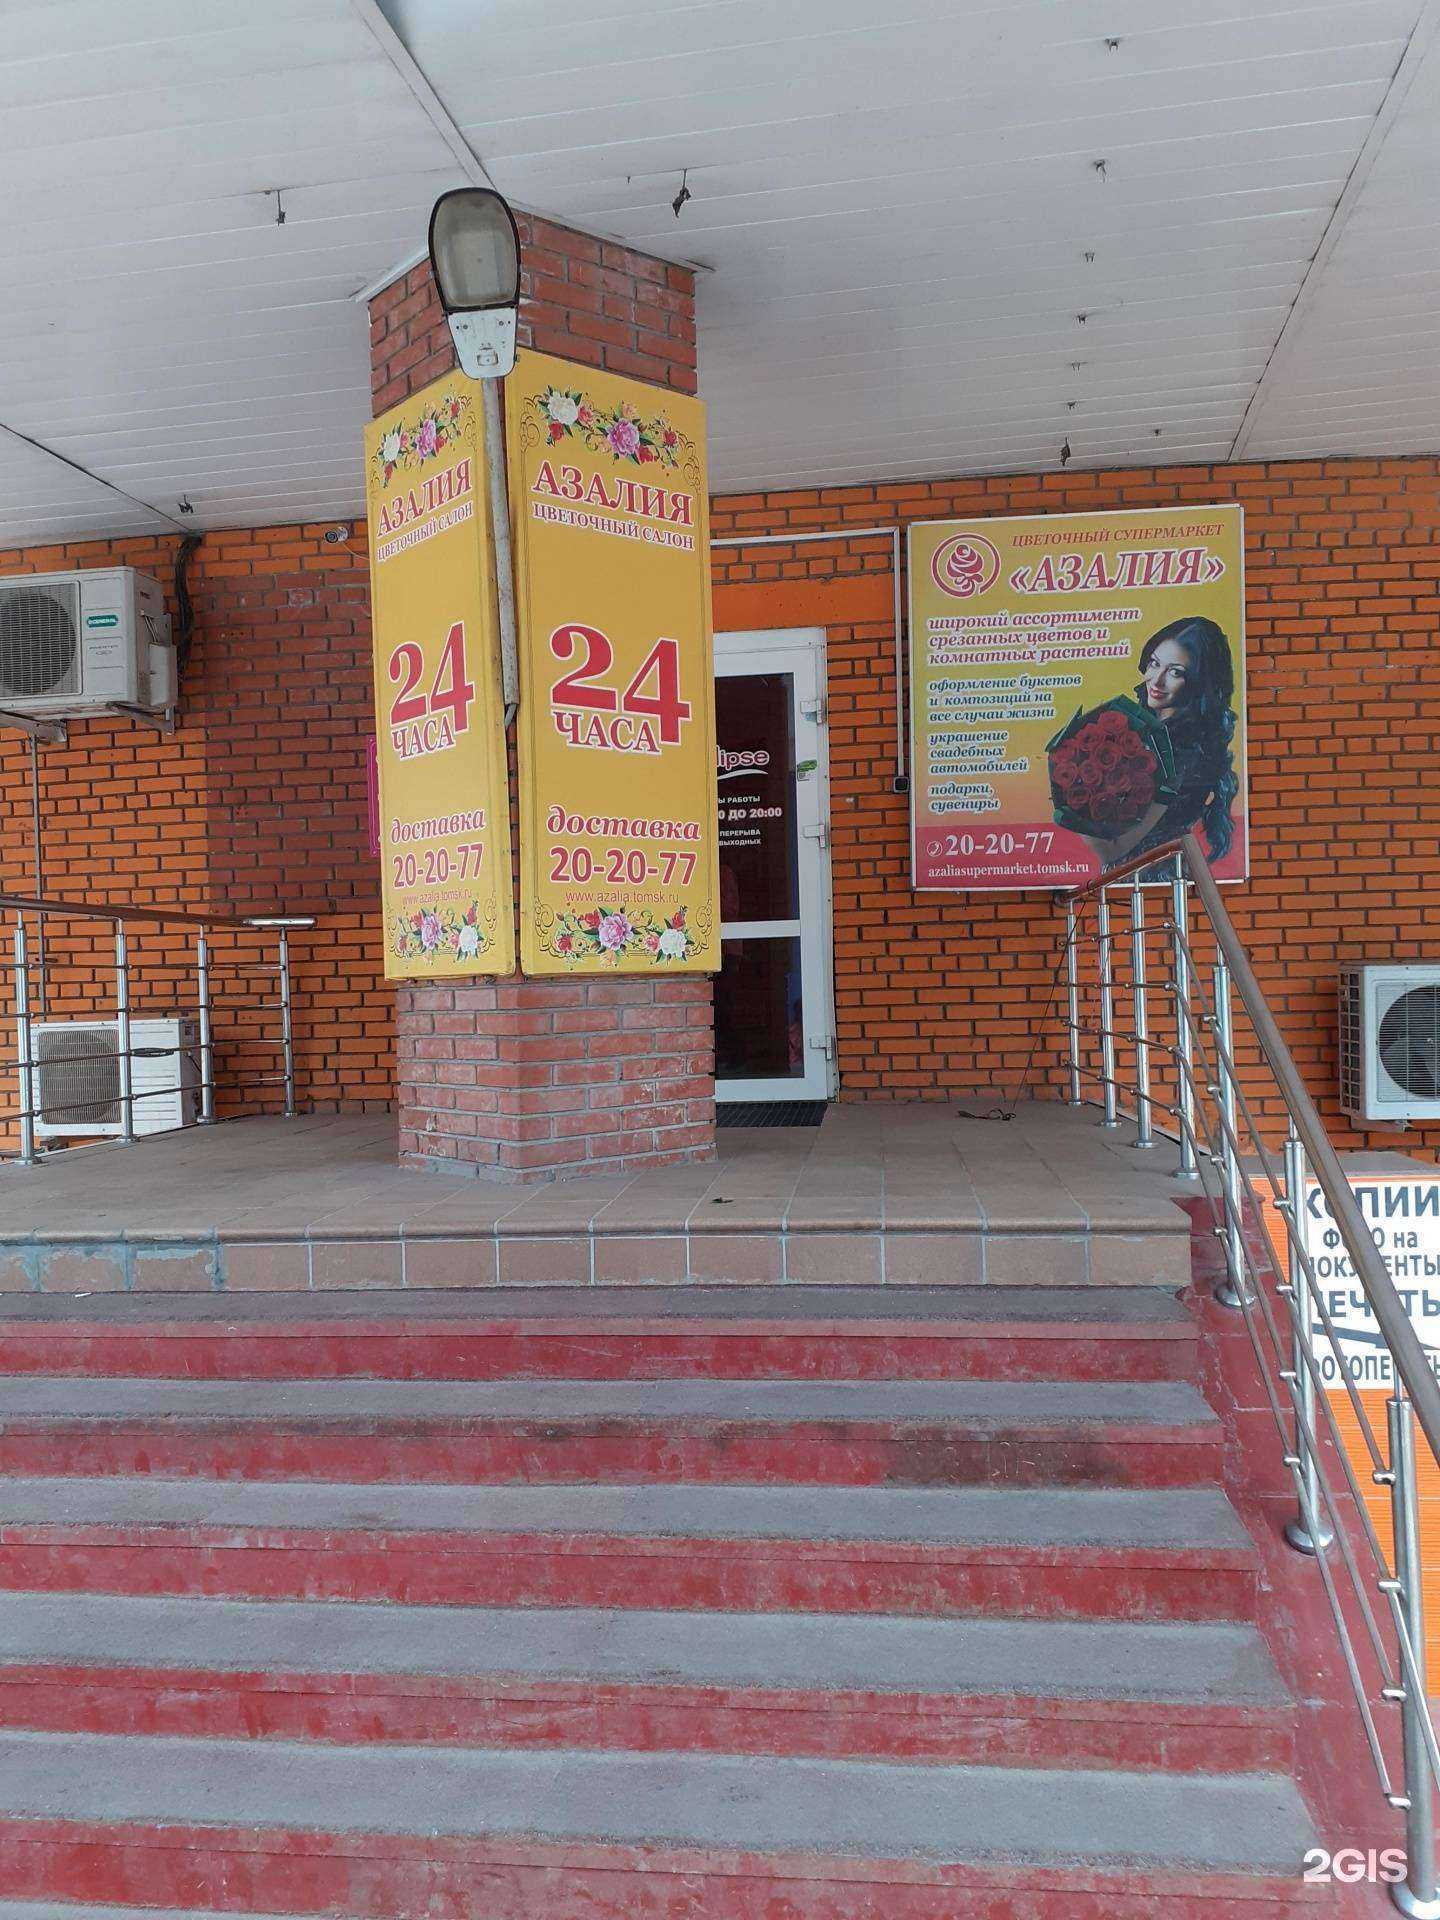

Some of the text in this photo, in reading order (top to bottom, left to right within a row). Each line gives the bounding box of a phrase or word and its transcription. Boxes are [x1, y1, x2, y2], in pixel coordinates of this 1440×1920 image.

[377, 459, 472, 538] АЗАЛИЯ
[532, 461, 693, 526] АЗАЛИЯ
[378, 502, 473, 560] ЦВЕТОЧНЫЙ САЛОН
[534, 503, 694, 549] ЦВЕТОЧНЫЙ САЛОН
[1012, 524, 1225, 547] ЦВЕТОЧНЫЙ СУПЕРМАРКЕТ
[1010, 549, 1225, 592] «АЗАЛИЯ»
[928, 607, 1140, 632] широкий ассортимент
[929, 629, 1108, 650] срезанных цветов и
[929, 642, 1130, 665] комнатных растений
[389, 621, 475, 733] 24
[550, 623, 691, 744] 24
[929, 673, 1081, 692] оформление букетов
[929, 690, 1052, 706] и композиций на
[929, 708, 1055, 724] все случаи жизни
[391, 715, 455, 760] ЧАСА
[552, 711, 660, 754] ЧАСА
[929, 731, 1009, 746] украшение
[716, 745, 770, 771] lipse
[930, 745, 1005, 759] свадебных
[930, 759, 1029, 774] автомобилей
[727, 796, 761, 804] РАБОТЫ
[930, 782, 994, 797] подарки,
[728, 809, 747, 821] ДО
[749, 807, 783, 819] 20:00
[930, 799, 1000, 813] сувениры
[391, 810, 485, 843] доставка
[547, 805, 701, 840] доставка
[945, 831, 1055, 857] 20-20-77
[393, 843, 483, 888] 20-20-77
[550, 846, 697, 885] 20-20-77
[928, 860, 1090, 879] azaliasupermarket.tomsk.ru
[565, 890, 679, 904] www.azalia.tomsk.ru
[1323, 1228, 1418, 1249] ФО на
[1317, 1290, 1440, 1318] ЕЧТЬ
